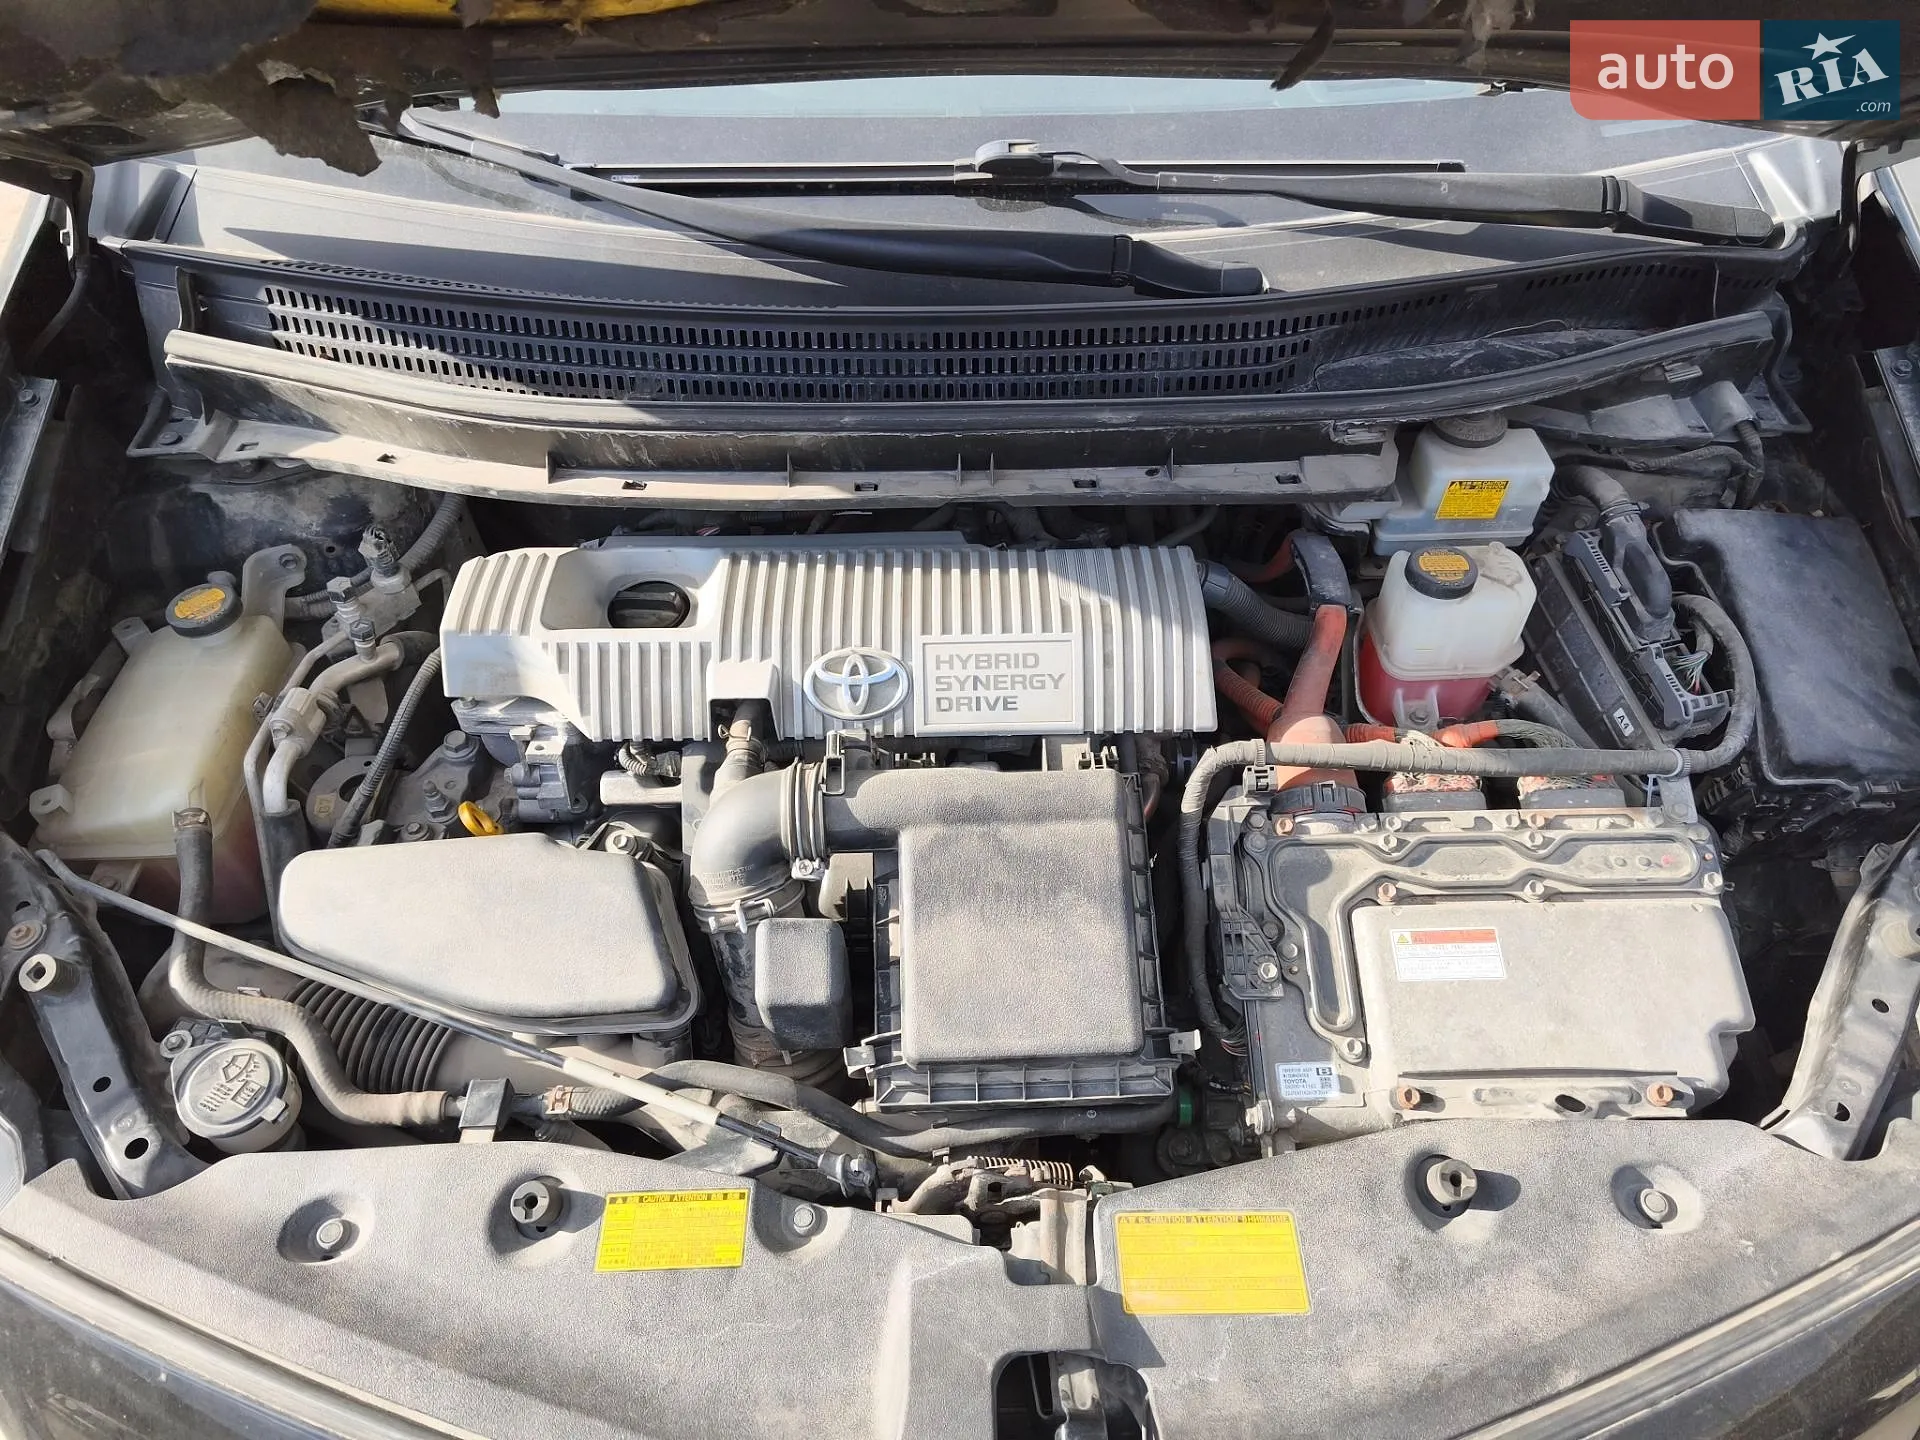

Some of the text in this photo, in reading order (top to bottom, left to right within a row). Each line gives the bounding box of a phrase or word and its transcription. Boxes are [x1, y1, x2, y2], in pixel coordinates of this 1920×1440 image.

[935, 652, 1040, 670] HYBRID
[935, 673, 1066, 692] SYNERGY
[935, 695, 1019, 712] DRIVE
[1617, 715, 1630, 729] A4
[642, 1193, 671, 1203] CAUTION
[672, 1191, 708, 1202] ATTENTION
[1149, 1216, 1187, 1224] CAUTION
[1192, 1216, 1238, 1224] ATTENTION
